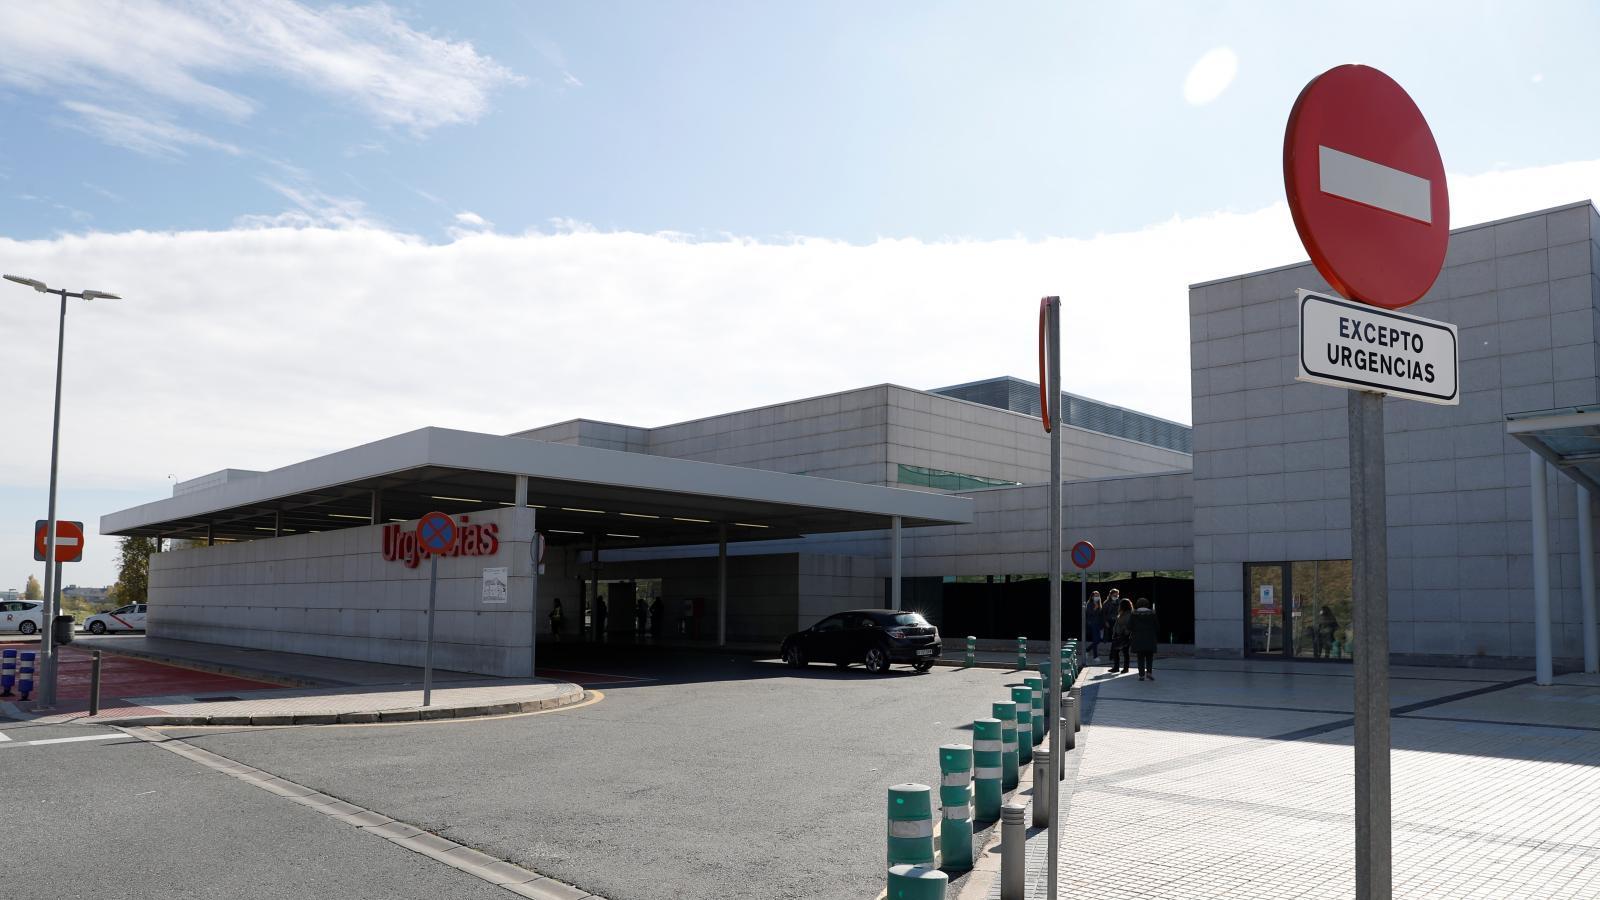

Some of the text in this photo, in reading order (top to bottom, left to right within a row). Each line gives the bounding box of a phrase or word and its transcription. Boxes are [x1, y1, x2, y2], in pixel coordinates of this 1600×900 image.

[1339, 316, 1424, 354] EXCEPTO
[1327, 342, 1435, 383] URGENCIAS
[382, 515, 499, 569] Urgias
